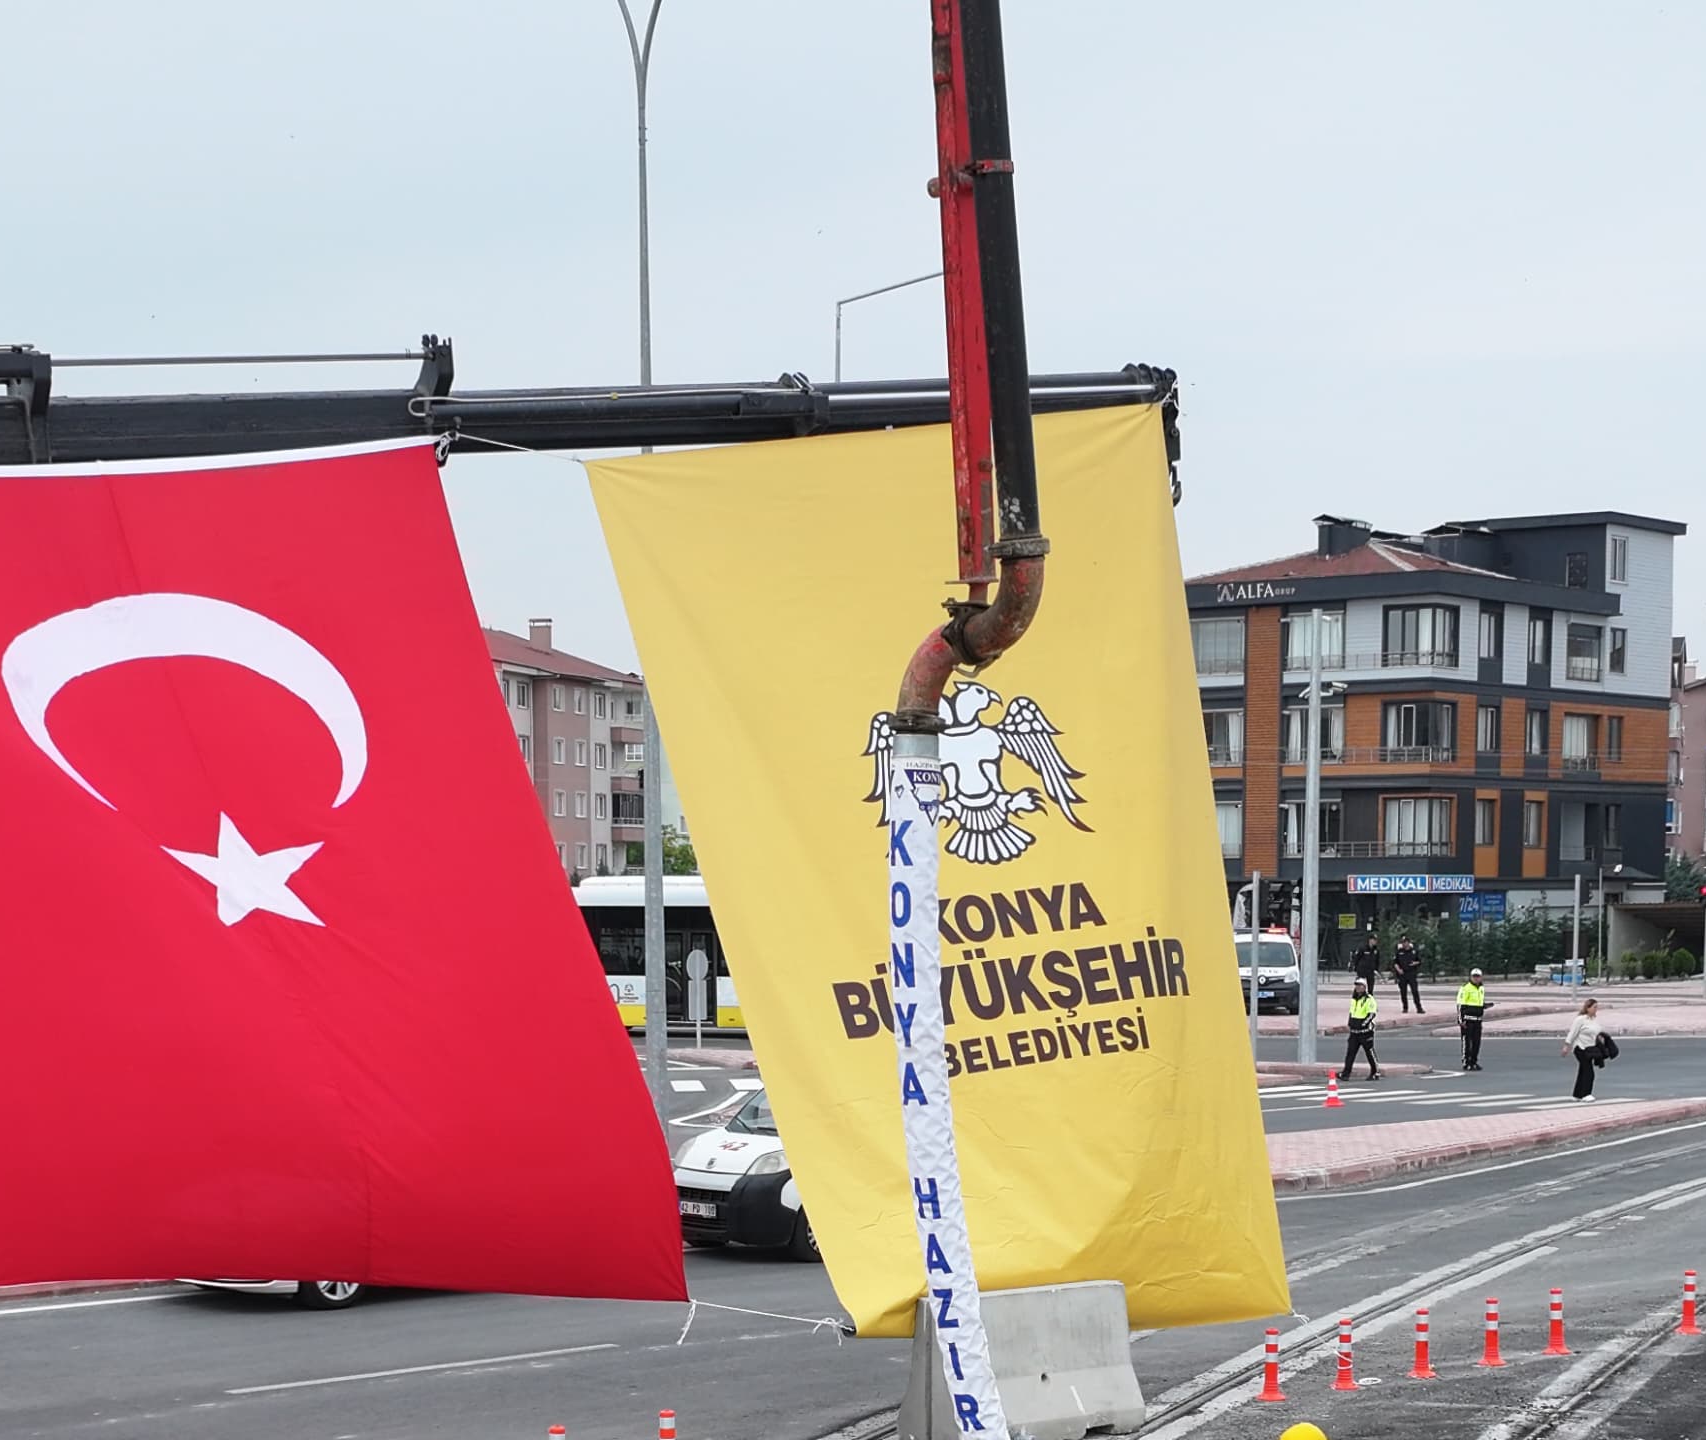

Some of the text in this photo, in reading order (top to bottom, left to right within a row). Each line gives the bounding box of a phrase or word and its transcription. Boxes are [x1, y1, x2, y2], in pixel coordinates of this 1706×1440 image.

[1236, 581, 1274, 599] ALFA
[1356, 876, 1426, 892] MEDİKAL
[1432, 876, 1473, 891] MEDİKAL
[942, 1006, 1150, 1079] BELEDİYESİ
[890, 820, 929, 1107] KONYA
[914, 1176, 985, 1432] HAZIR
